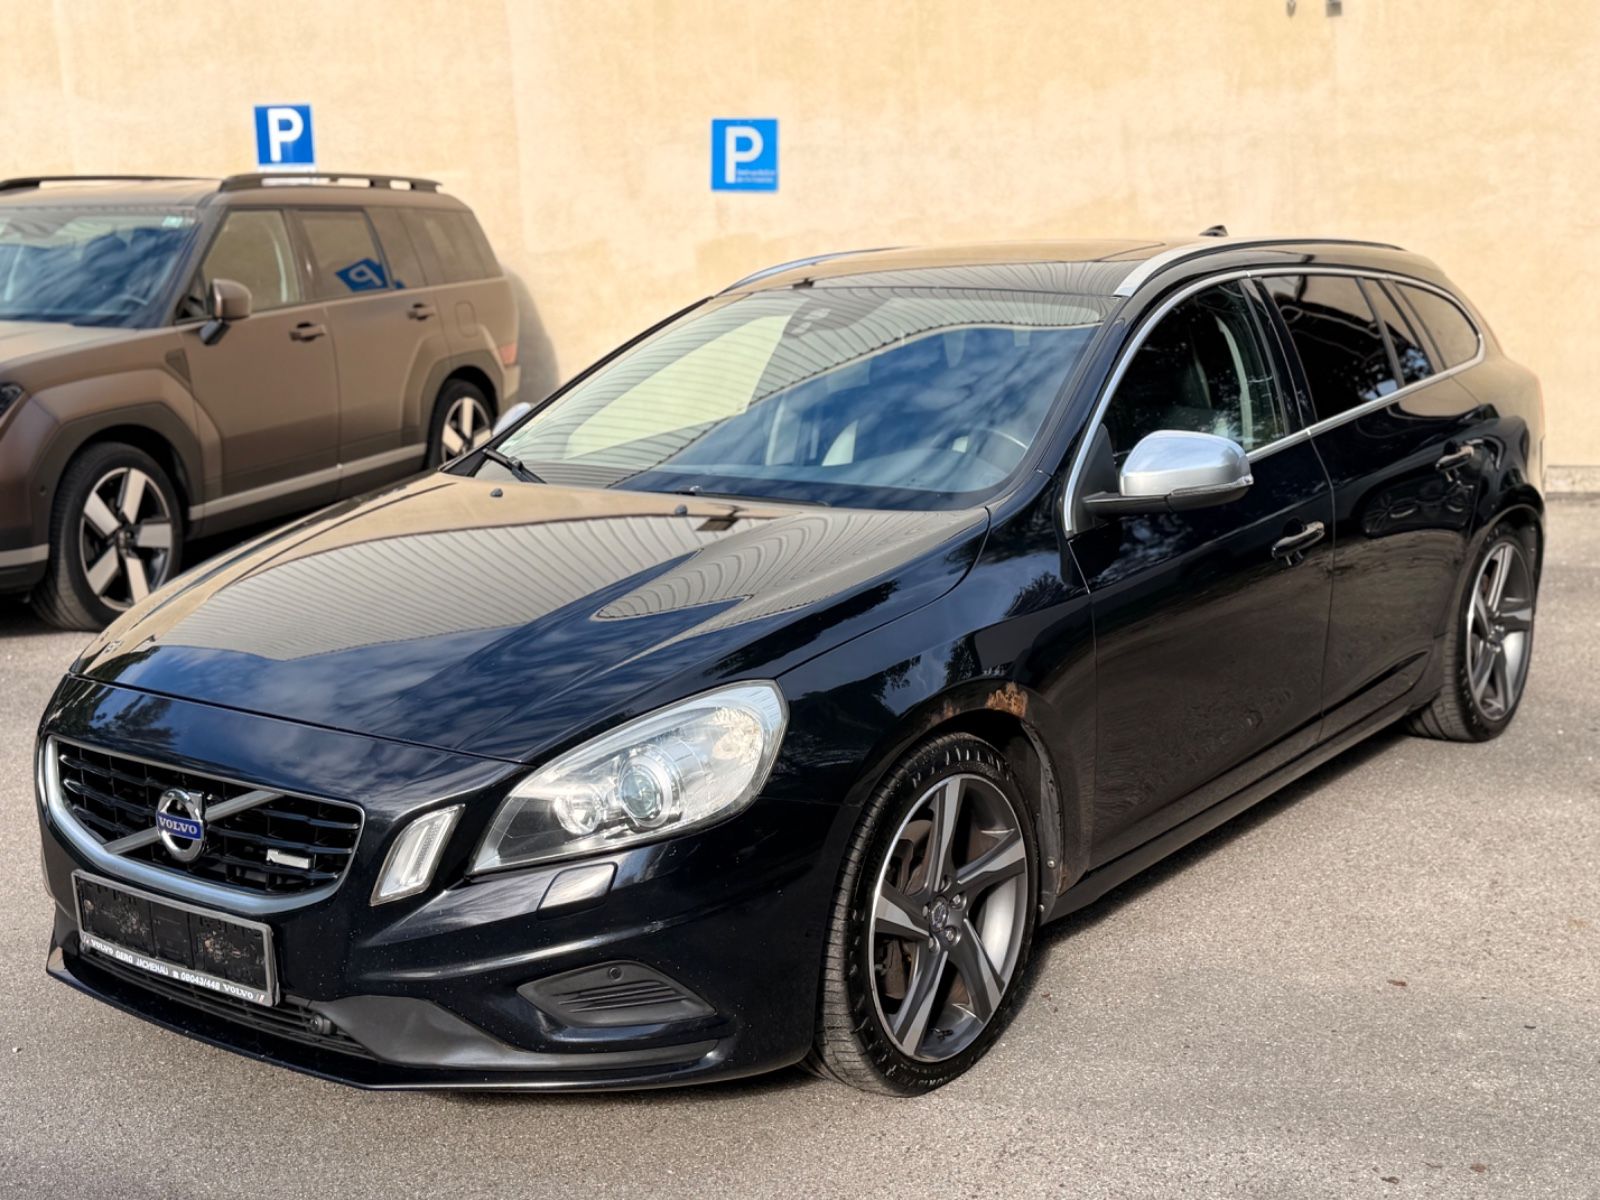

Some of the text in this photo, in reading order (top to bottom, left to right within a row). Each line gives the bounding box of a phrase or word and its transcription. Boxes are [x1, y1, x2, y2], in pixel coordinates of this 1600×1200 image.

[267, 107, 304, 162] P
[725, 125, 764, 184] P
[158, 816, 198, 835] VOLVO
[91, 939, 114, 955] VOLVO
[222, 982, 254, 999] VOLVO
